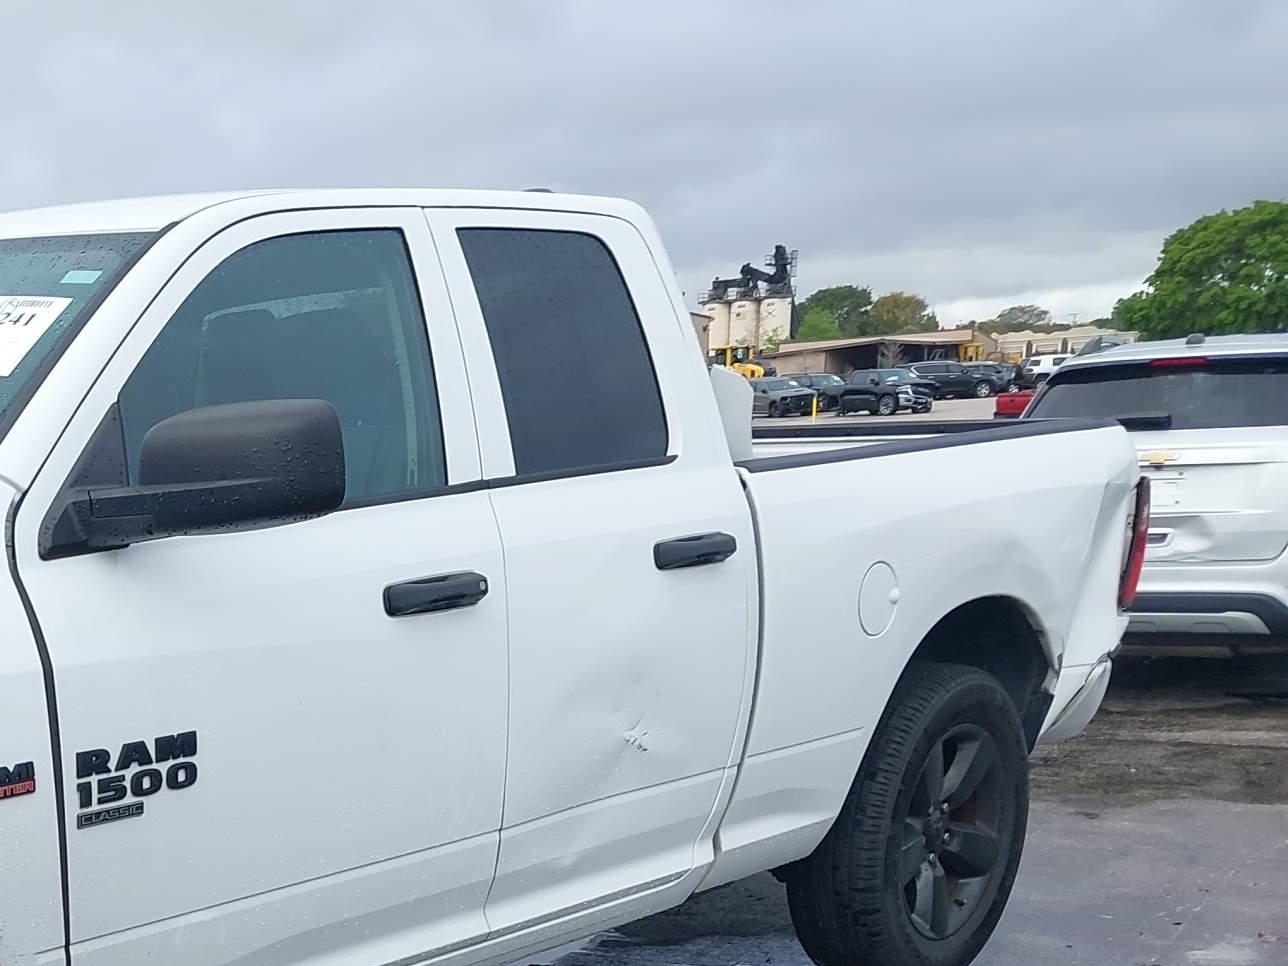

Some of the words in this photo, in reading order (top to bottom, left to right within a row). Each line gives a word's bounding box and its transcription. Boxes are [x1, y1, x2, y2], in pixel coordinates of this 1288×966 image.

[75, 730, 198, 779] RAM
[76, 761, 198, 809] 1500
[80, 803, 143, 827] CLASSIC
